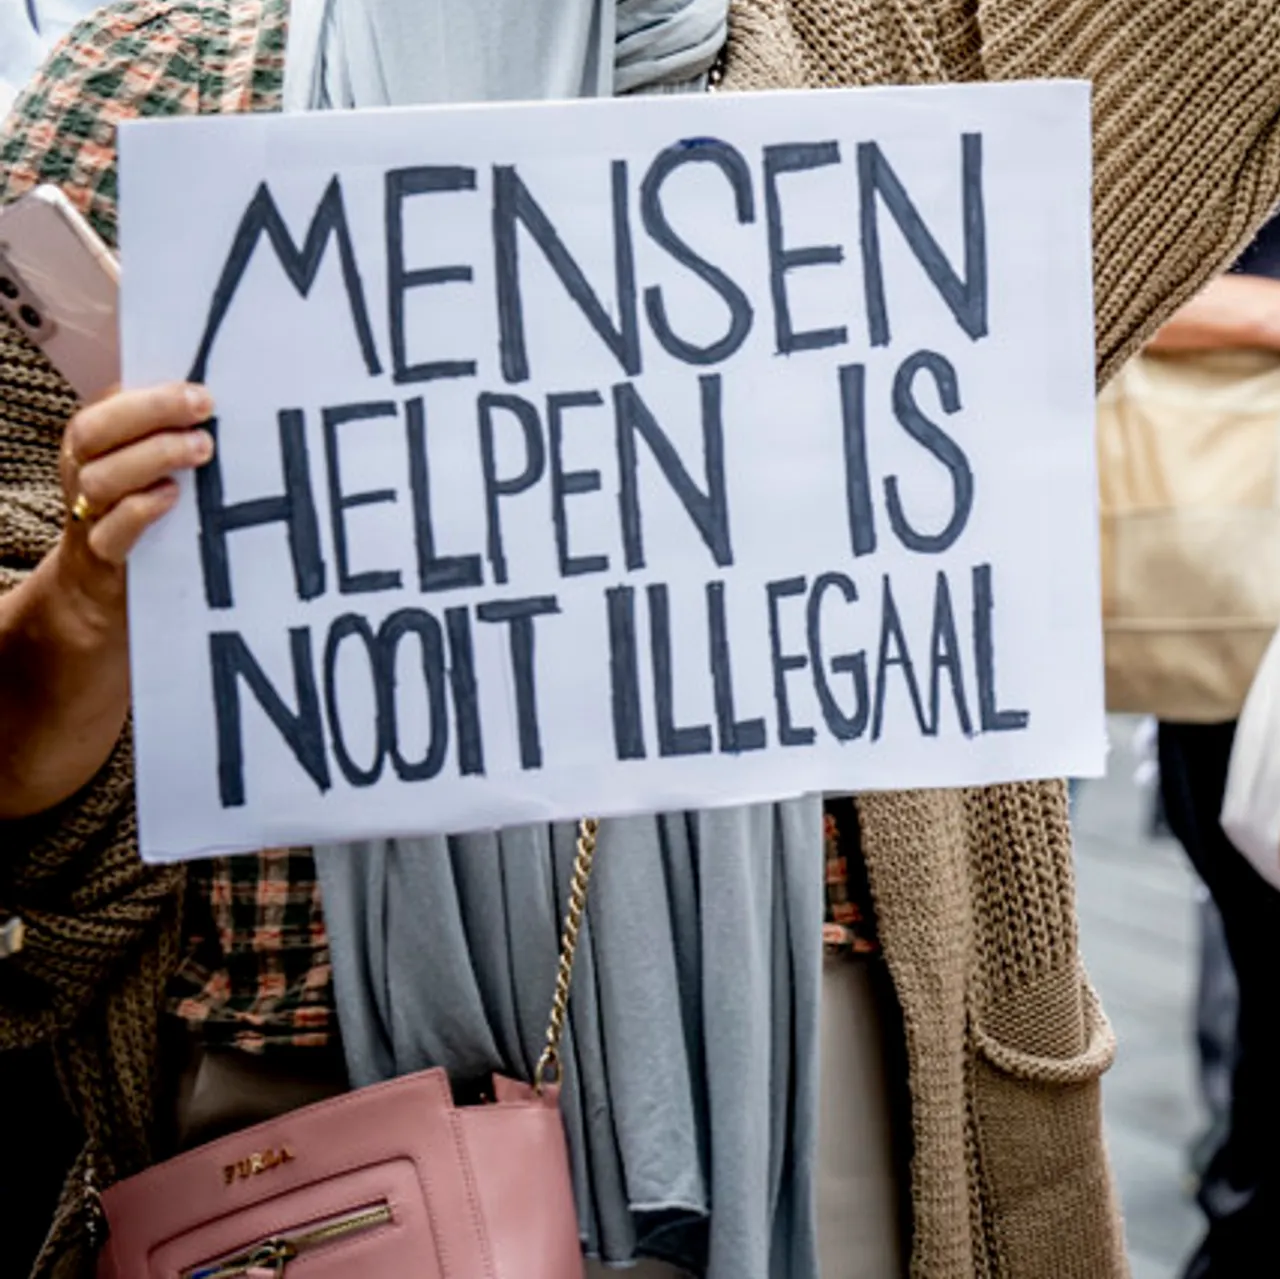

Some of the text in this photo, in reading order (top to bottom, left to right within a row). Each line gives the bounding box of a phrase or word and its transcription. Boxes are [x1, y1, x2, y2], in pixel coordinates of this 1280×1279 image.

[187, 132, 990, 383] MENSEN
[196, 349, 976, 609] HELPEN IS
[207, 563, 1031, 809] NOOIT ILLEGAAL
